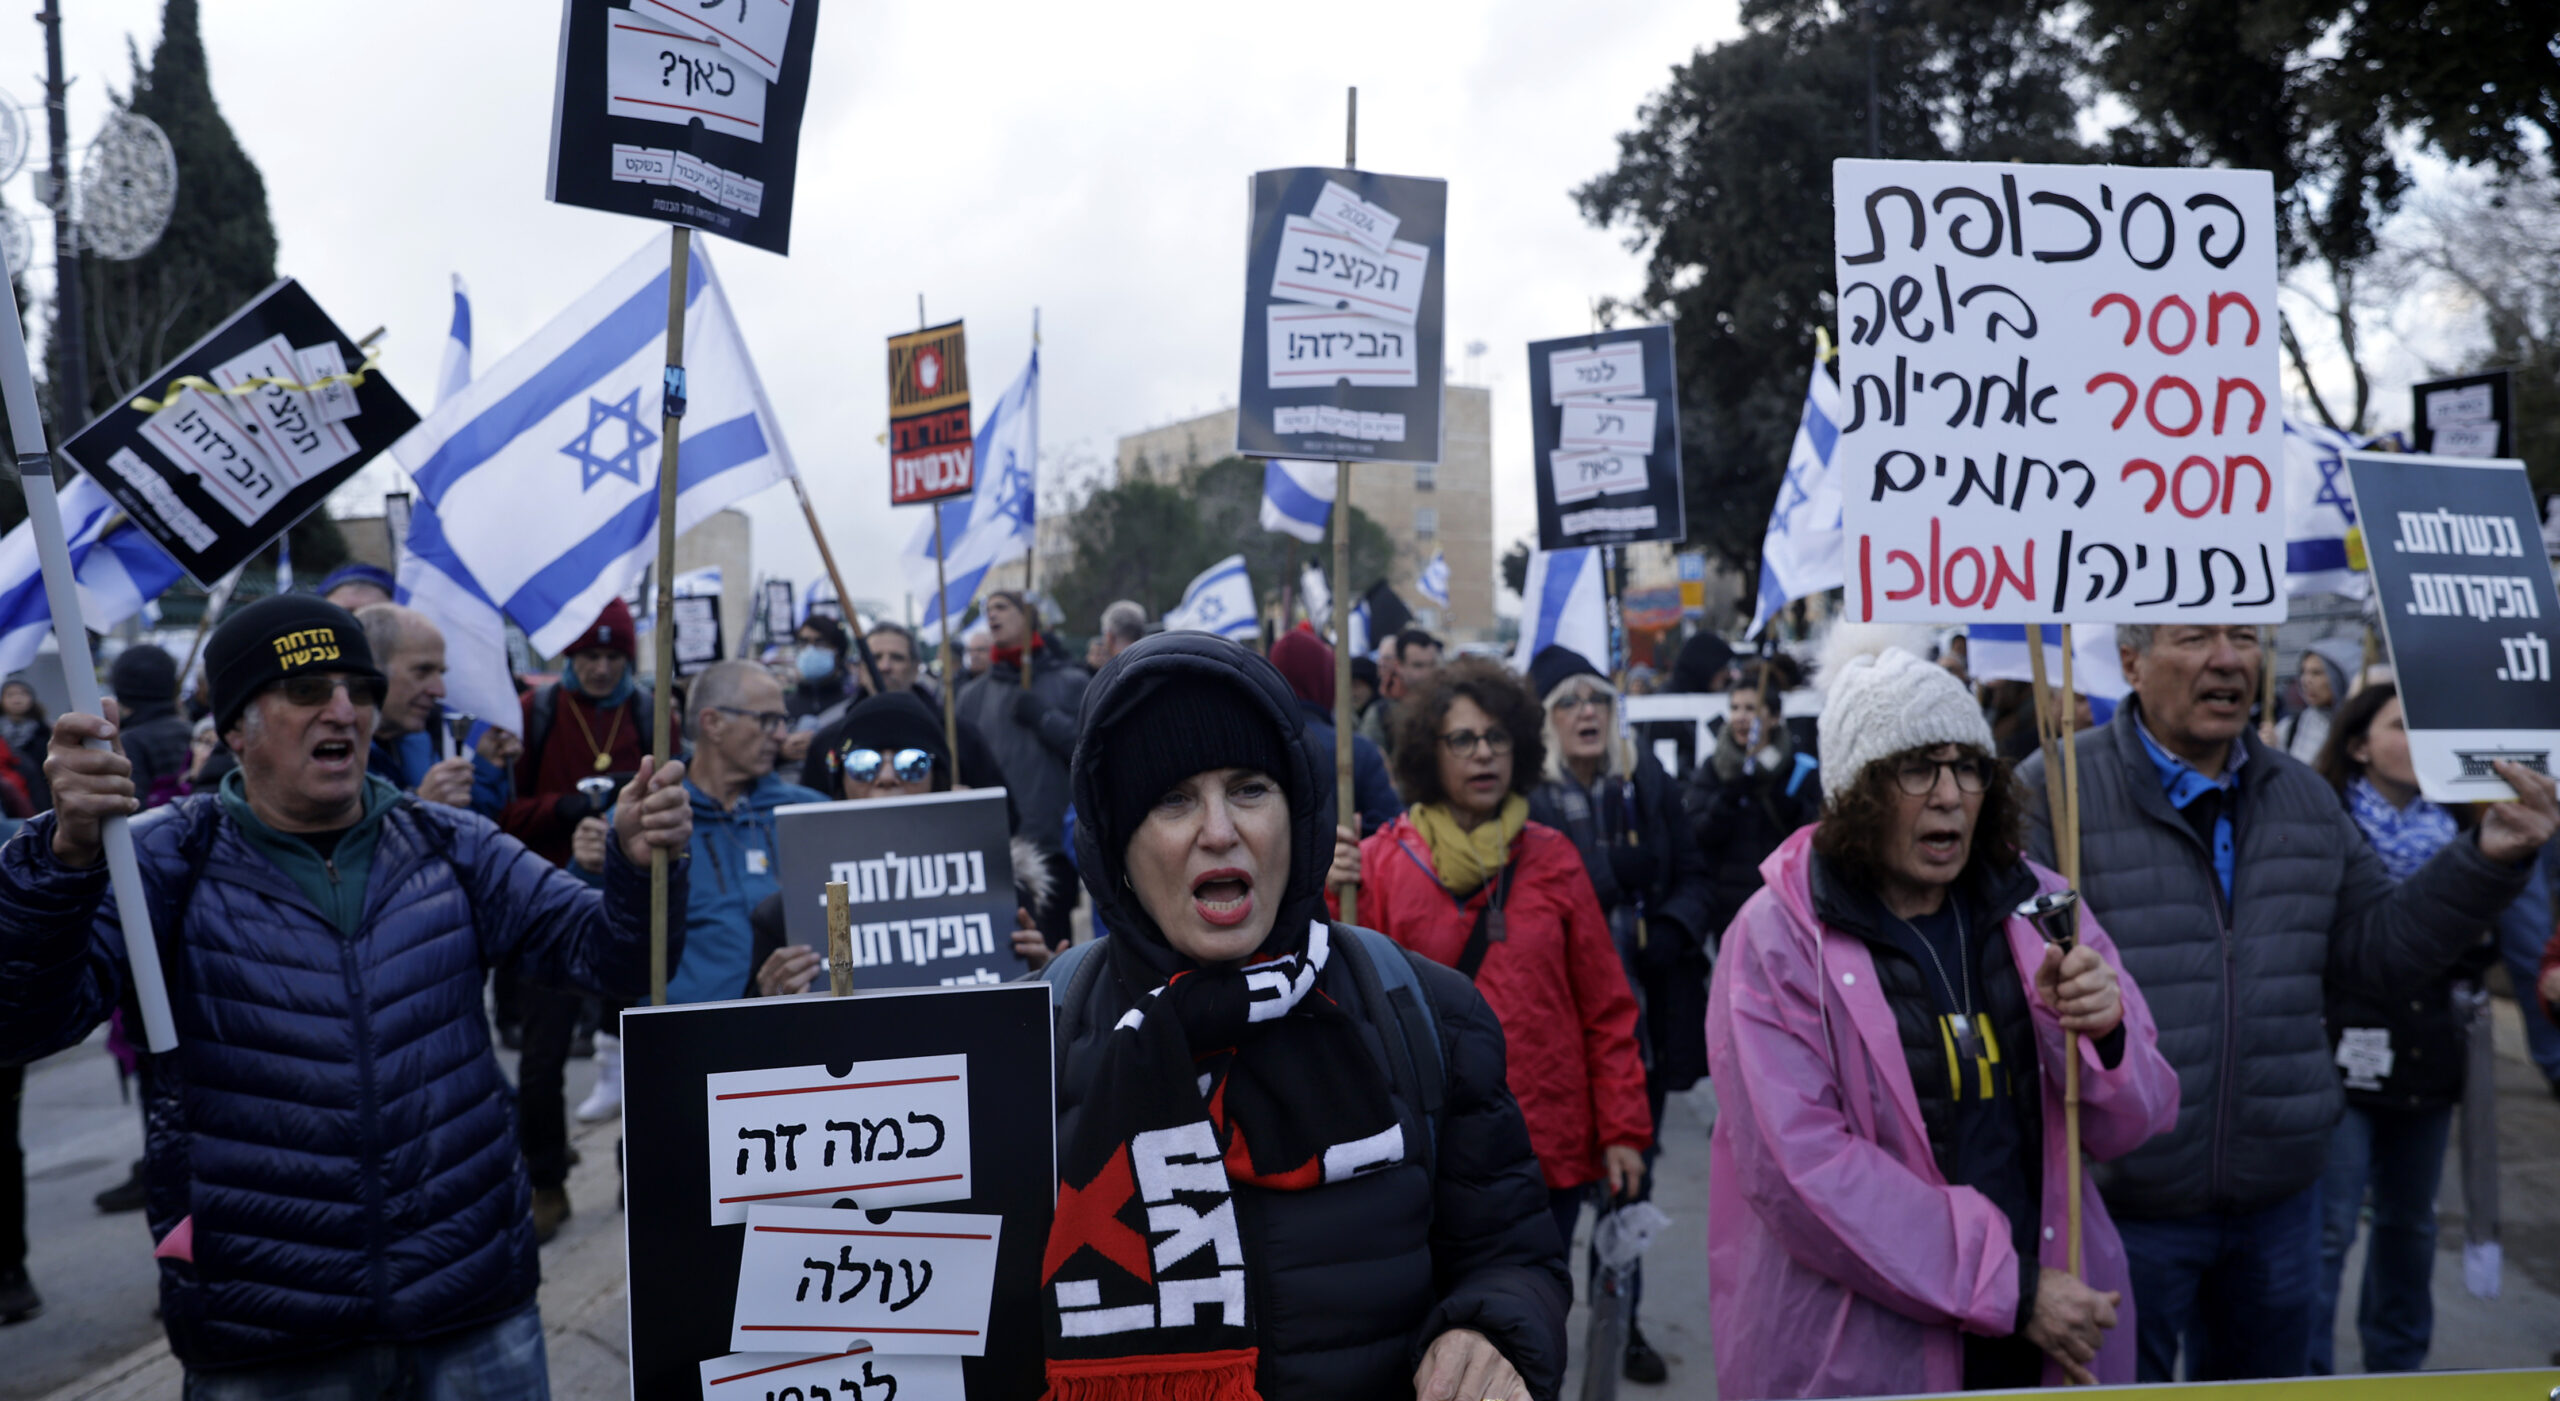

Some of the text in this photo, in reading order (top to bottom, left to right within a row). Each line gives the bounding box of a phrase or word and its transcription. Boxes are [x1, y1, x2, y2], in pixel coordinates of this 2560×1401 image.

[625, 158, 663, 173] בשקט
[1337, 203, 1376, 233] 2024
[1842, 174, 2245, 269] פסיכופת
[1296, 247, 1400, 291] תקציב
[1844, 264, 2260, 355] חסר בושה
[1288, 332, 1403, 360] הביזה!
[1842, 355, 2266, 436] חסר אחריות
[175, 409, 274, 499] הביזה!
[895, 446, 973, 496] עכשיו!
[1871, 450, 2272, 518] חסר רחמים
[2394, 507, 2525, 557] נכשלתם.
[1859, 516, 2276, 622] נתניהו מסוכן
[2406, 572, 2540, 622] הפקרתם.
[272, 628, 335, 654] הדחה
[280, 645, 340, 671] עכשיו
[2497, 631, 2551, 682] לכו.
[736, 1111, 945, 1175] כמה זה
[795, 1245, 933, 1312] עולה
